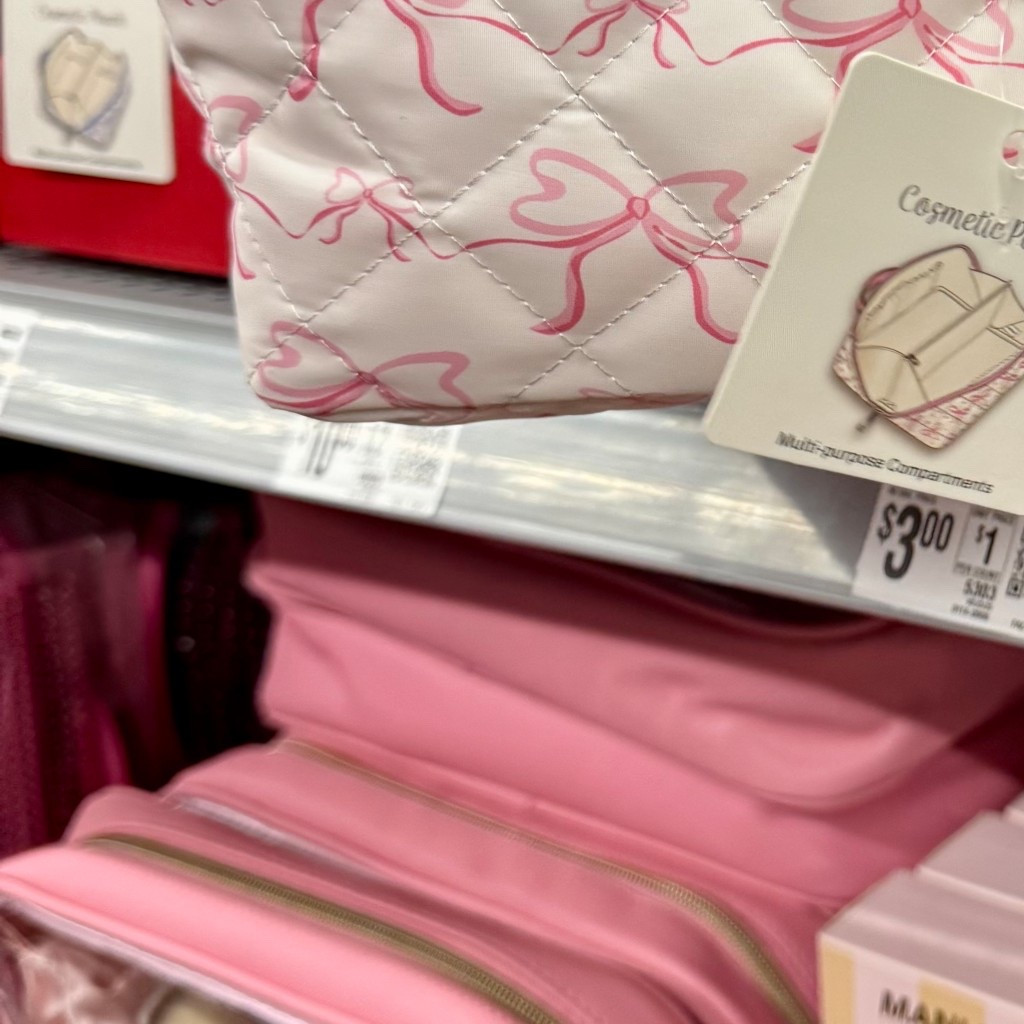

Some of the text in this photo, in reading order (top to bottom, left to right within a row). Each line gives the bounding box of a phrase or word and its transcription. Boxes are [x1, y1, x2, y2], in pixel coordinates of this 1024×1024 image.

[897, 184, 1006, 240] Cosmetic
[775, 430, 995, 494] Multi-purpose Compartments
